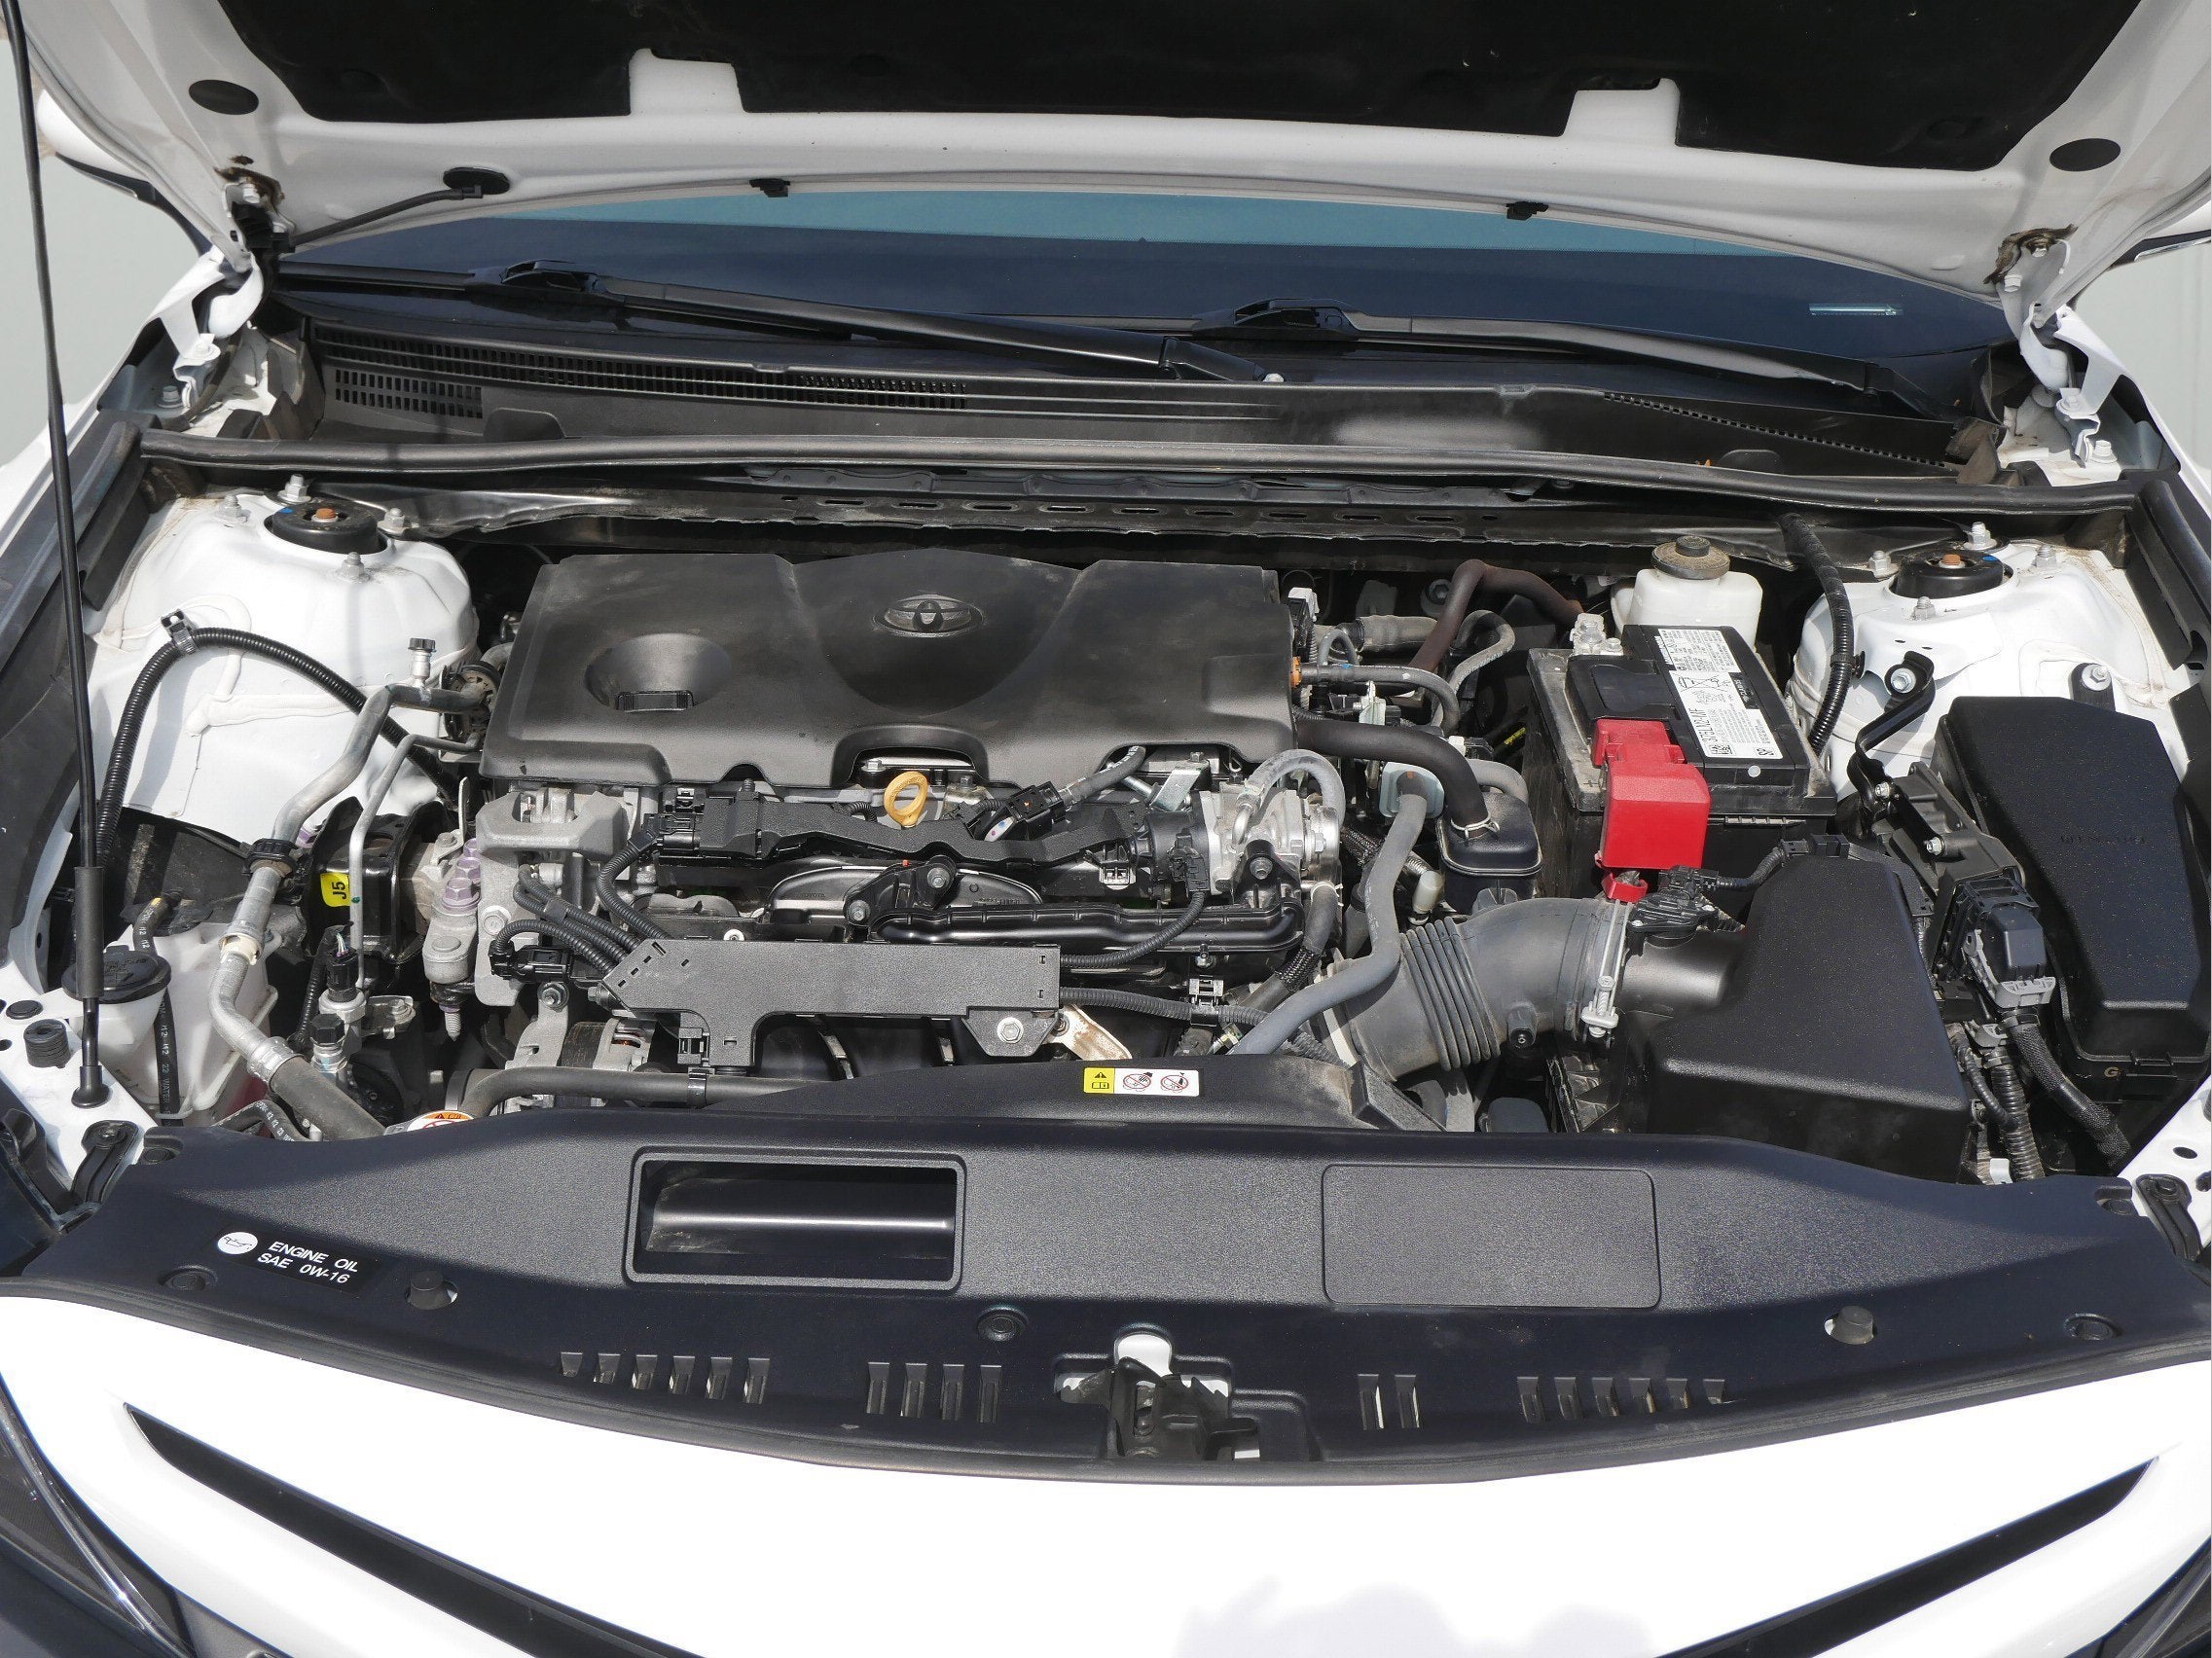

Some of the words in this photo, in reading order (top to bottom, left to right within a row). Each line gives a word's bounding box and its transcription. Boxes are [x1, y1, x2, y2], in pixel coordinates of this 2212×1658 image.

[332, 881, 347, 900] J5
[257, 1252, 293, 1270] SAE
[299, 1264, 350, 1284] 0W-16
[268, 1242, 329, 1263] ENGINE
[334, 1257, 359, 1273] OIL
